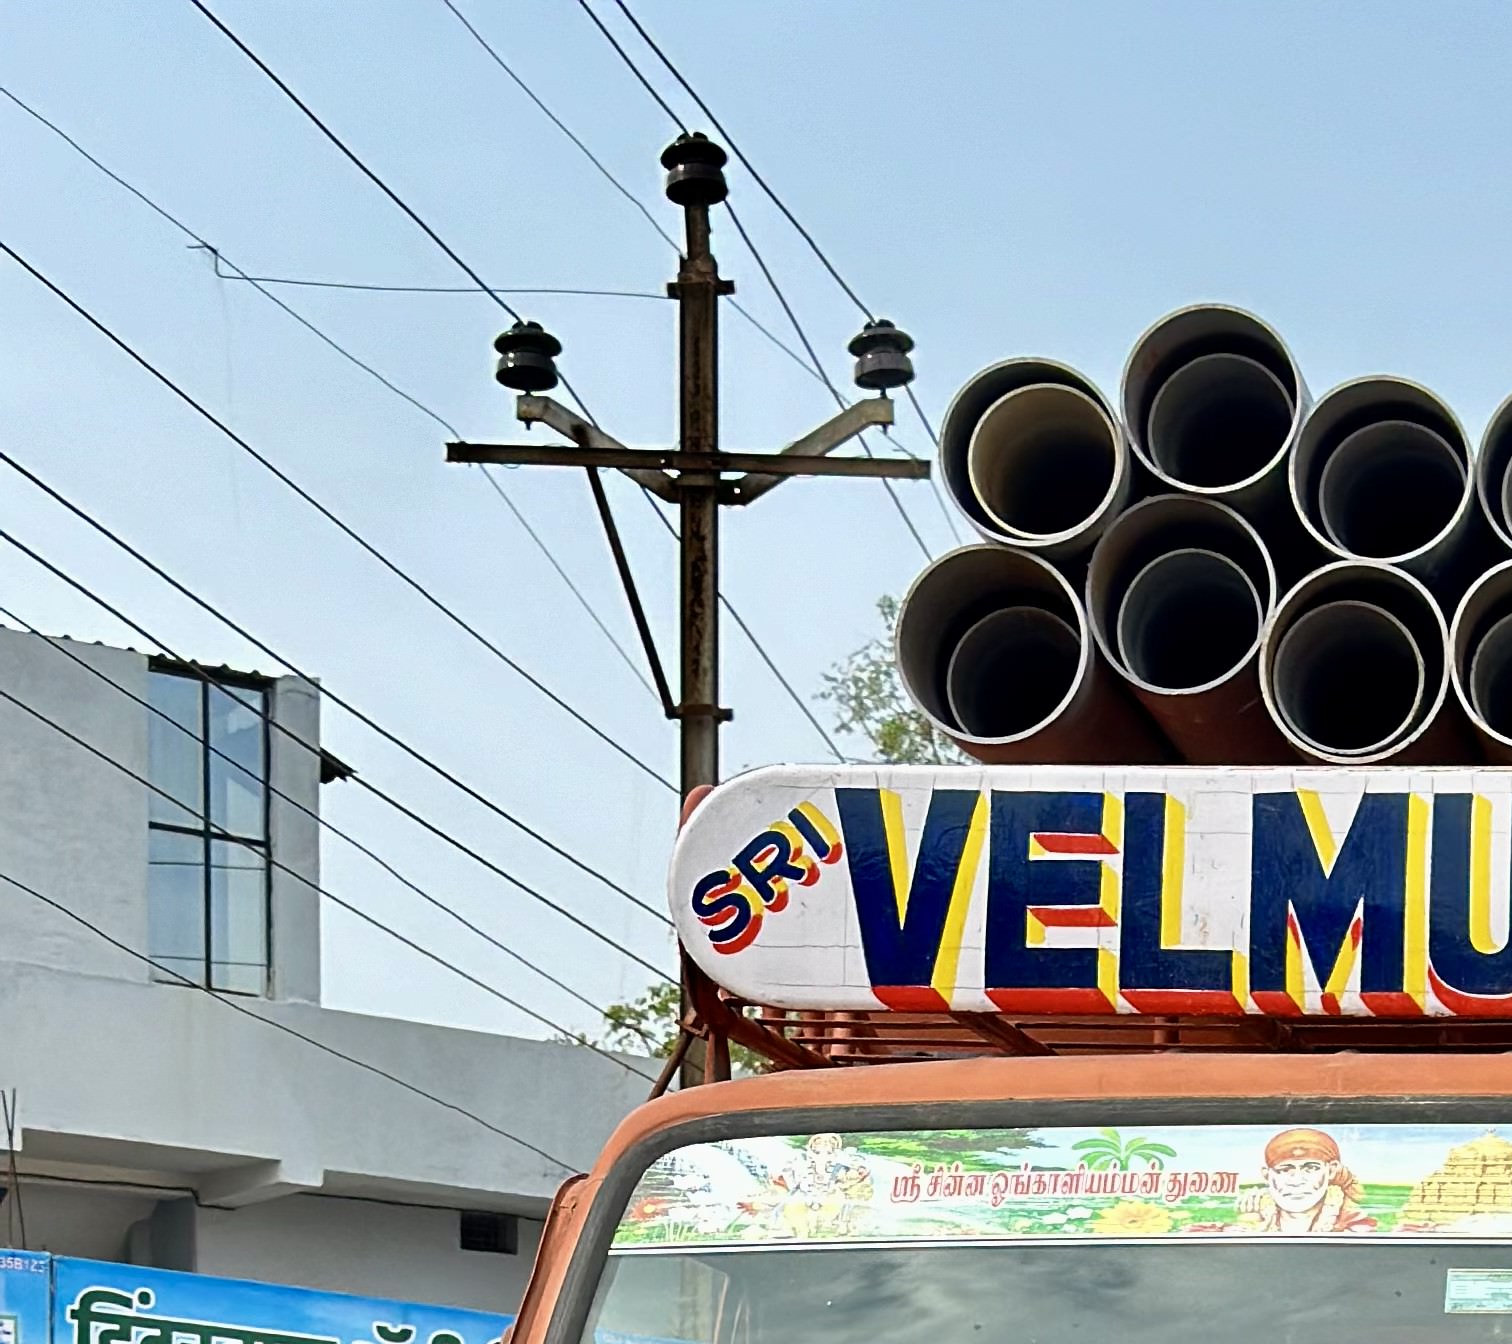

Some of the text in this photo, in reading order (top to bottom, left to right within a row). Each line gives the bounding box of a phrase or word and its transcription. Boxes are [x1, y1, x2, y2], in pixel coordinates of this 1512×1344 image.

[691, 798, 842, 955] SRI
[926, 1163, 986, 1197] சின்ன
[1166, 1170, 1238, 1202] துணை
